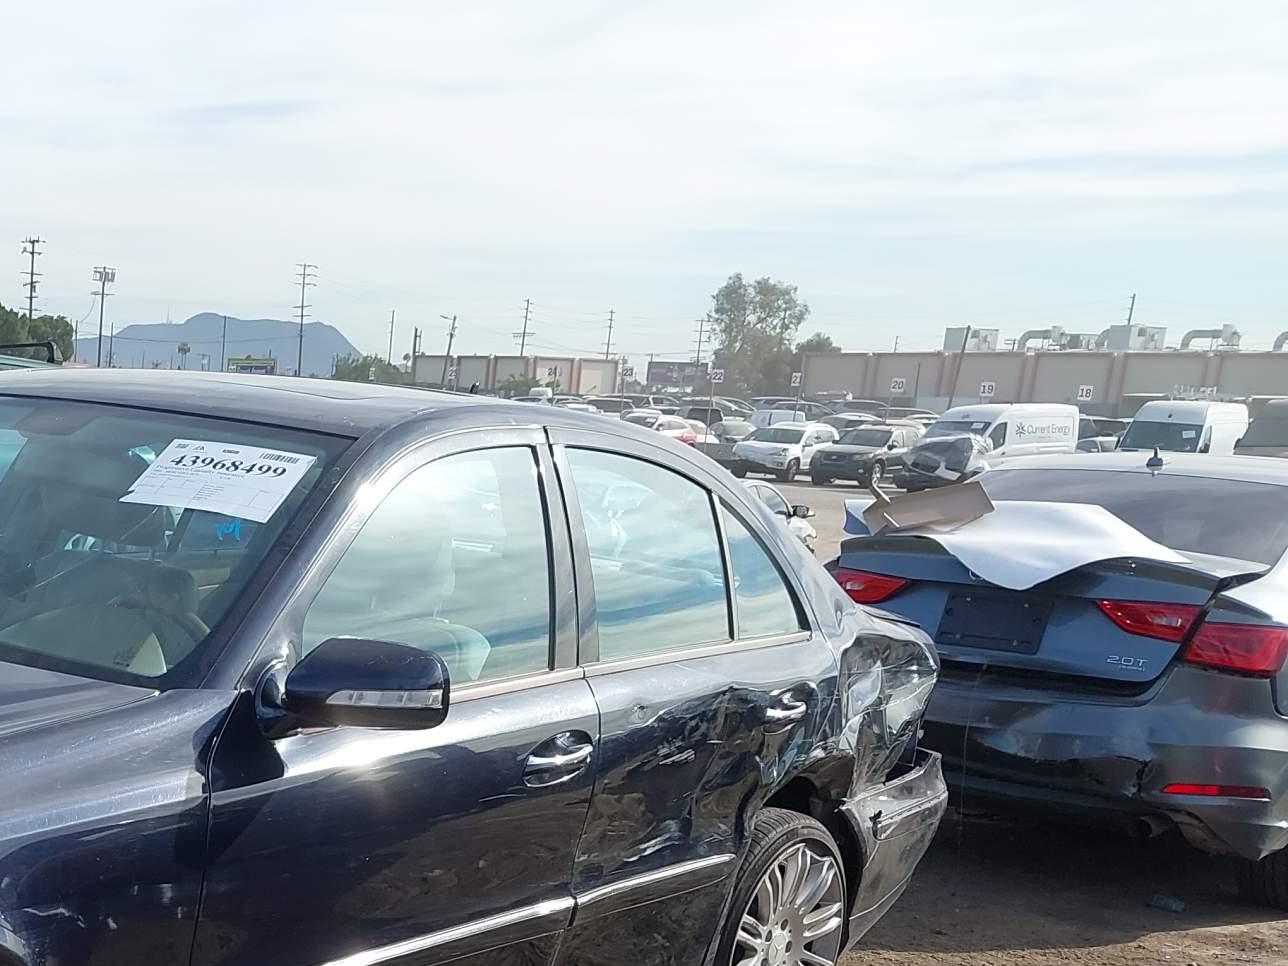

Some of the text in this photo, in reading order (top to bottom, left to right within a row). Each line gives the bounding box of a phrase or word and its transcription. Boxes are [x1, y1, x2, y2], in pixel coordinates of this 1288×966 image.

[623, 368, 634, 377] 23
[712, 371, 724, 380] 22
[891, 380, 905, 390] 20
[980, 384, 994, 394] 19
[1079, 388, 1092, 398] 18
[1027, 424, 1071, 436] Current Energy
[170, 454, 288, 478] 43968499
